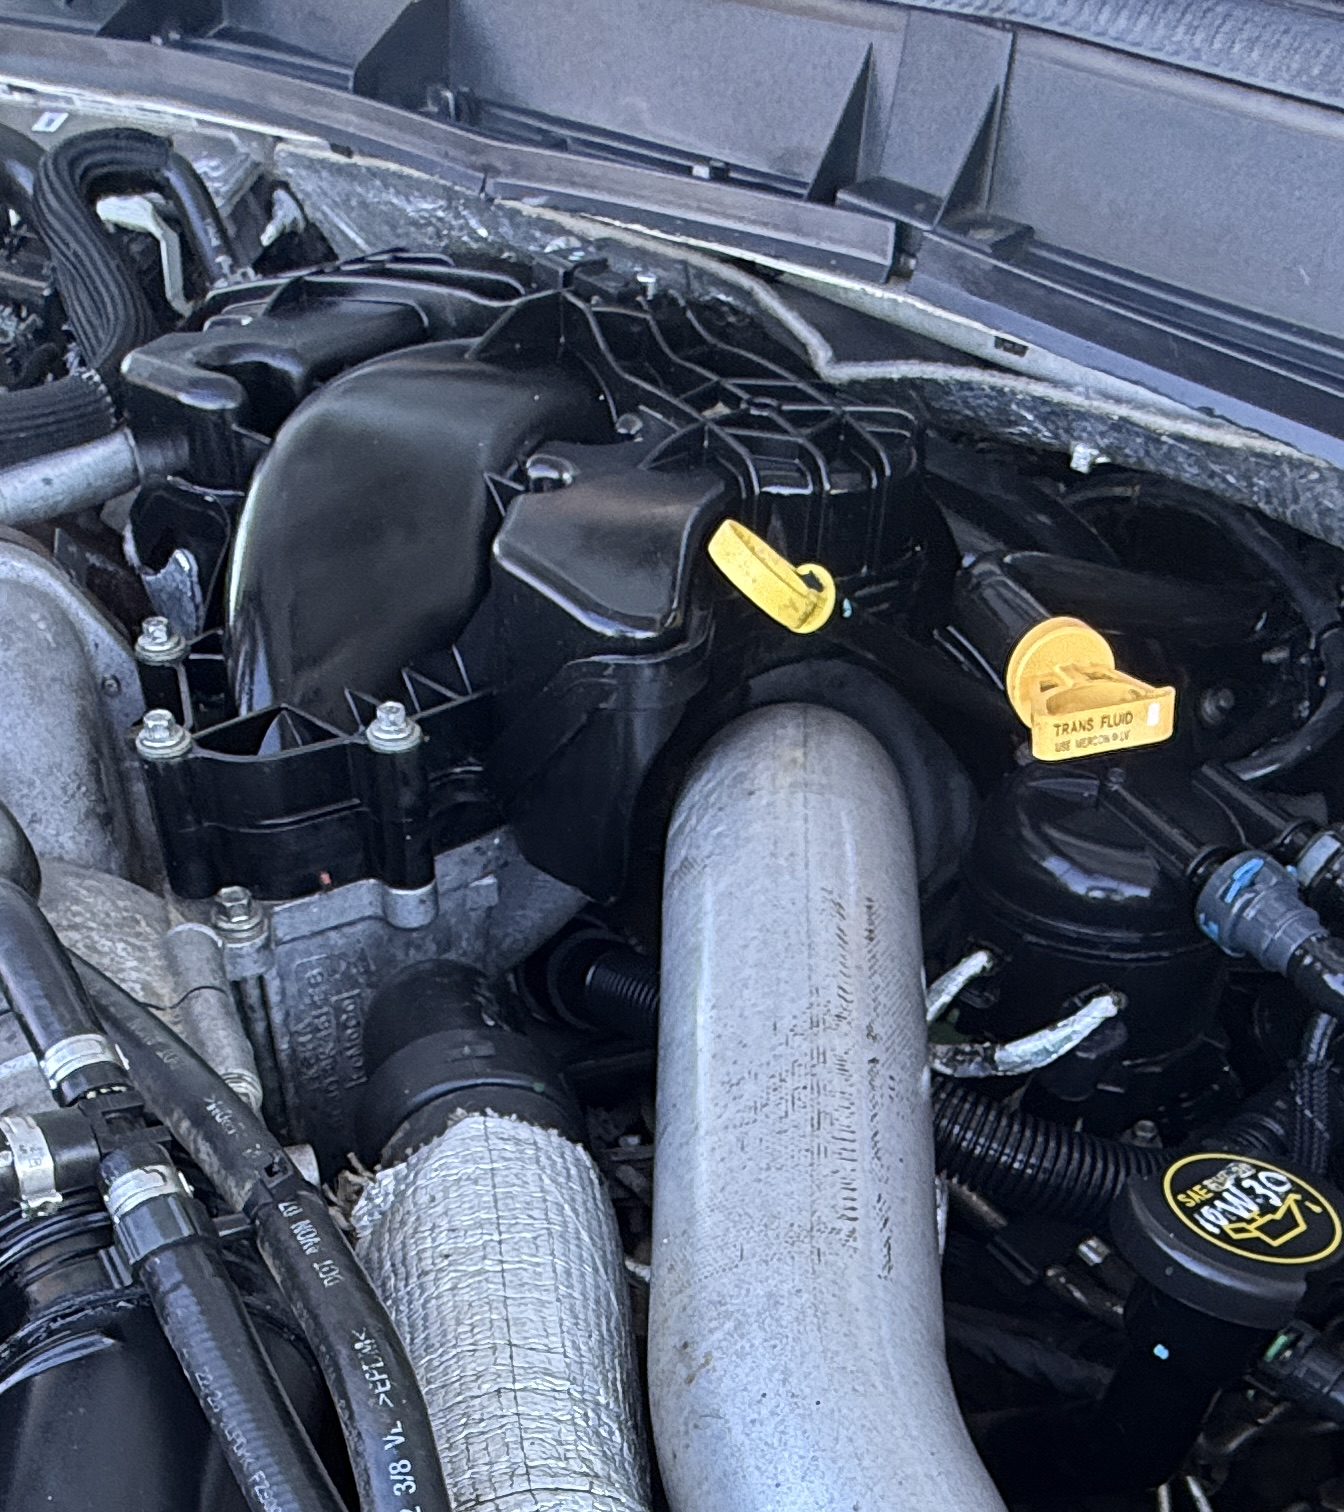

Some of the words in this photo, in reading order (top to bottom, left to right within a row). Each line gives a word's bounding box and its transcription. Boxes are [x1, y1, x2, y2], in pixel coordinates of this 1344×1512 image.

[1053, 719, 1094, 737] TRANS
[1100, 711, 1134, 729] FLUID
[1177, 1186, 1214, 1208] SAE
[289, 1217, 326, 1256] AVON
[312, 1257, 345, 1287] DOT
[384, 1456, 419, 1498] 3/8
